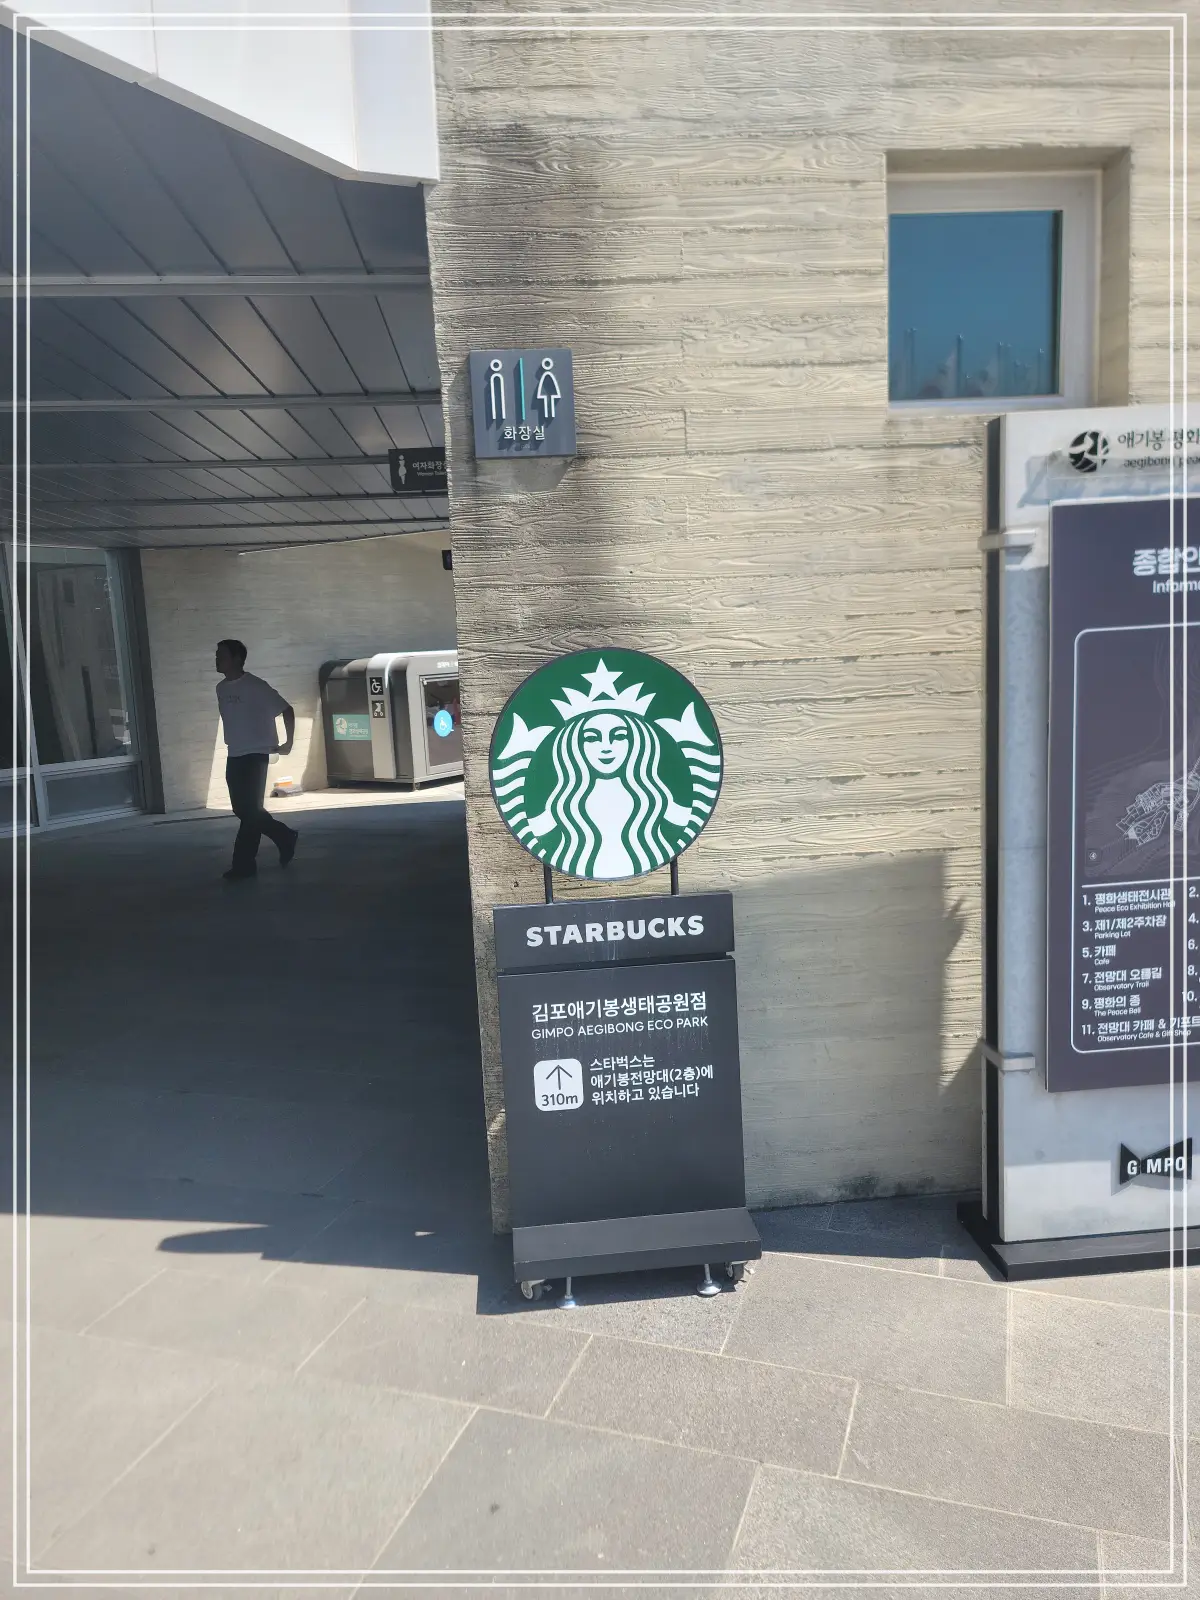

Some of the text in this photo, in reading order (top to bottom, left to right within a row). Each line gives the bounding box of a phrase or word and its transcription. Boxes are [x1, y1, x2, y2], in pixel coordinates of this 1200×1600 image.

[503, 425, 545, 441] 화장실
[1117, 430, 1165, 451] 애기봉
[1082, 888, 1173, 906] 1. 평화생태전시관
[1188, 886, 1200, 898] 2.
[1094, 900, 1176, 914] Peace Eco Exhibition Hal
[1082, 914, 1167, 932] 3. 제1/제2주차장
[1187, 912, 1200, 924] 4.
[526, 915, 705, 947] STARBUCKS
[1094, 931, 1119, 940] Parking
[1082, 944, 1116, 958] 5. 카페
[1187, 939, 1198, 950] 6.
[1094, 957, 1110, 966] Cafe
[1081, 973, 1092, 984] 7.
[1094, 969, 1127, 984] 전망대
[1187, 964, 1198, 976] 8.
[1094, 980, 1150, 991] Observatory Trail
[531, 990, 707, 1024] 김포애기봉생태공원점
[1081, 994, 1141, 1010] 9. 평화의 종
[1093, 1010, 1106, 1018] The
[1107, 1008, 1128, 1017] Peace
[531, 1015, 709, 1040] GIMPO AEGIBONG ECO PARK
[1081, 1024, 1095, 1035] 11.
[1097, 1021, 1130, 1035] 전망대
[1132, 1019, 1155, 1032] 카페
[1157, 1018, 1167, 1030] &
[1097, 1033, 1138, 1043] Observatory
[1138, 1031, 1154, 1040] Cafe
[1161, 1029, 1173, 1037] Gif
[1174, 1028, 1192, 1037] Shp
[589, 1054, 656, 1072] 스타벅스는
[590, 1063, 714, 1089] 애기봉전망대(2층)에
[541, 1092, 579, 1107] 310m
[591, 1083, 700, 1107] 위치하고 있습니다
[1127, 1156, 1186, 1175] GMPO
